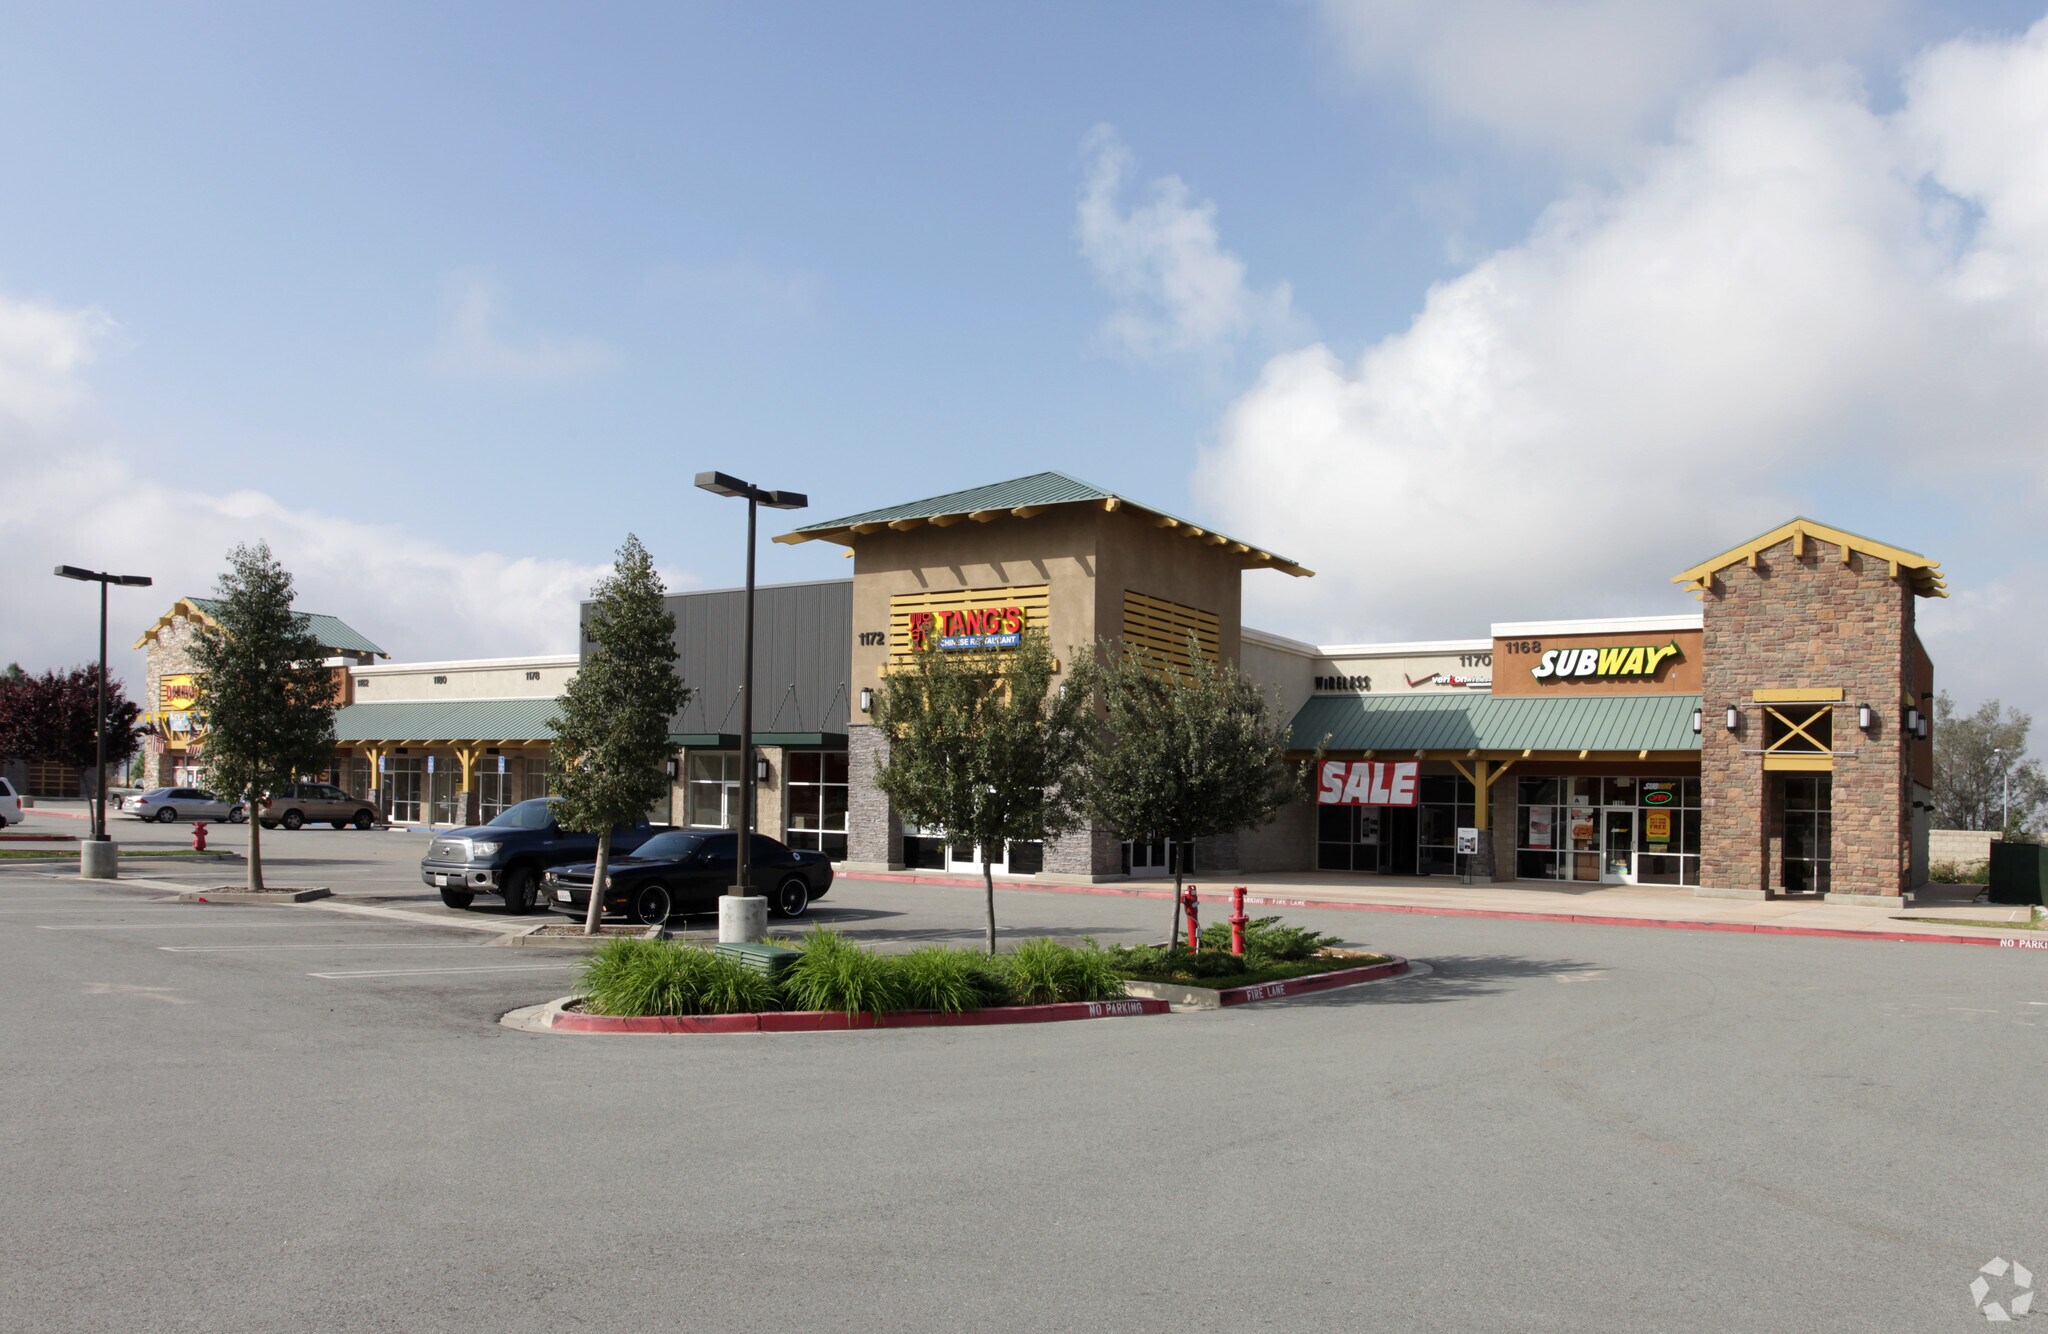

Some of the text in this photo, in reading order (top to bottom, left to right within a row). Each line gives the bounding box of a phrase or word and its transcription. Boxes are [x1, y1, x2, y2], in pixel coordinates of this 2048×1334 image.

[939, 607, 1020, 636] TANG'S
[858, 631, 885, 646] 1172
[1505, 640, 1542, 654] 1168
[1459, 655, 1492, 667] 1170
[1531, 640, 1679, 681] SUBWAY
[1318, 761, 1418, 804] SALE
[1643, 782, 1676, 790] SUBWAY
[2000, 939, 2014, 947] NO
[1246, 984, 1286, 1001] FIRE LANE
[1088, 1002, 1143, 1016] NO PARKING
